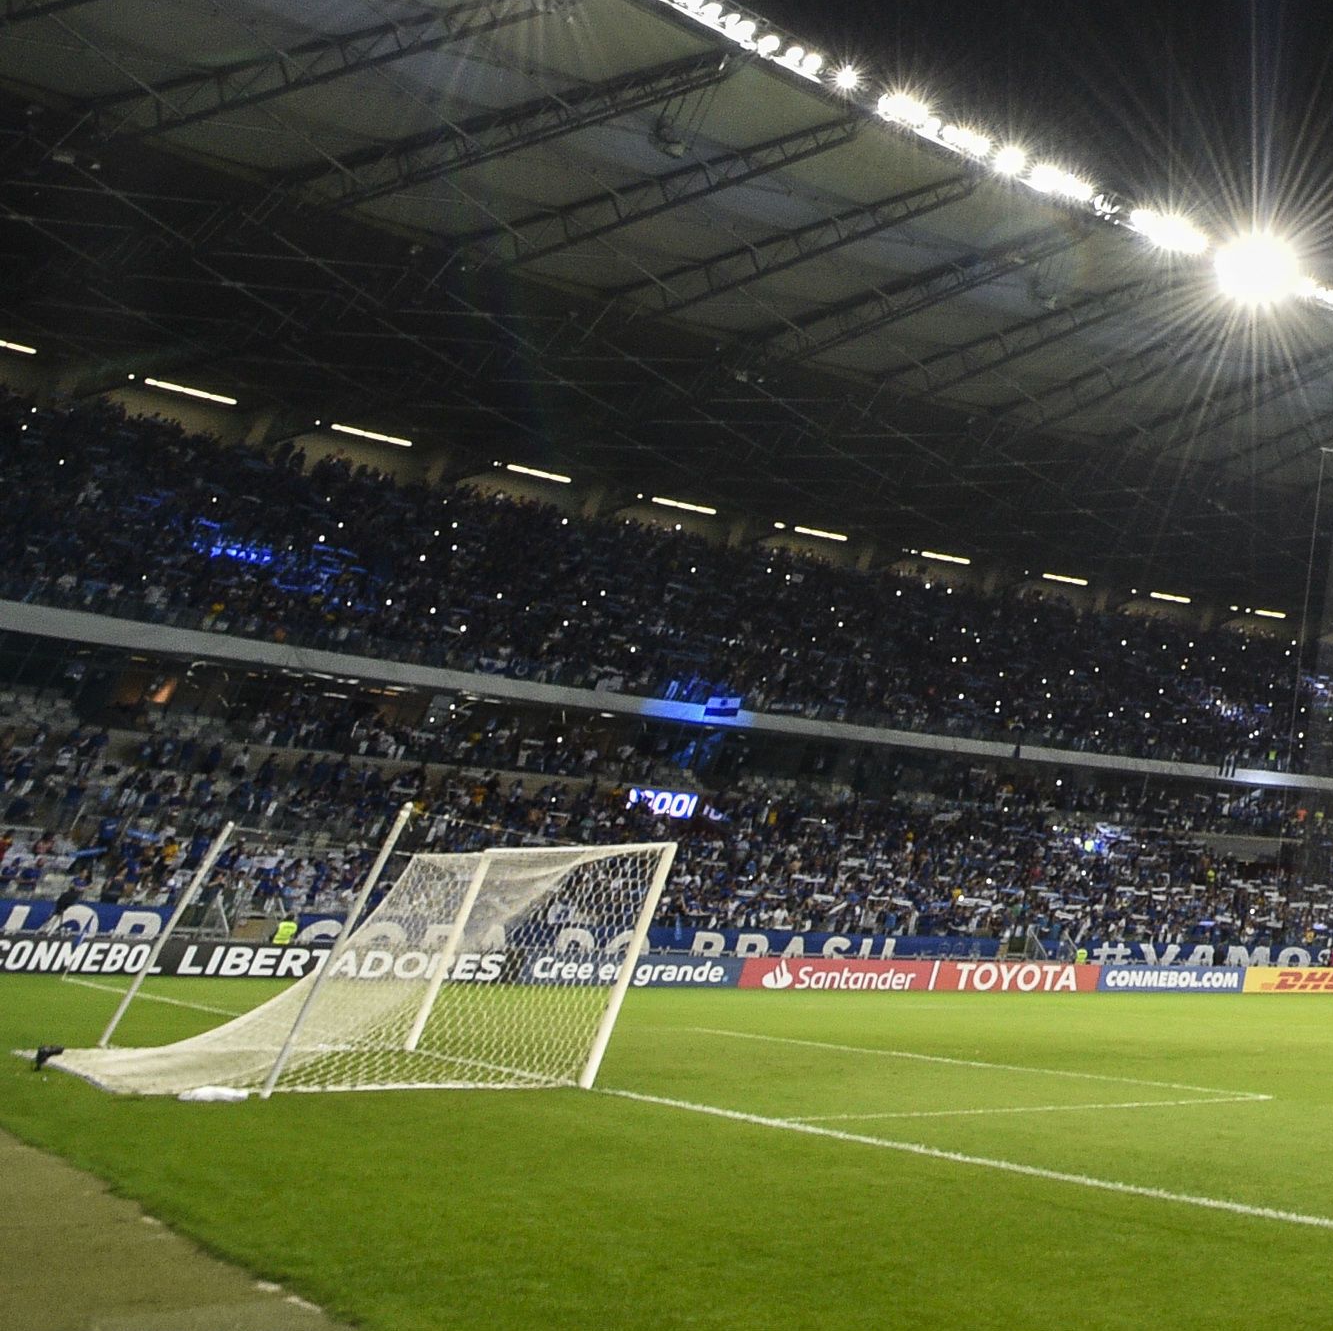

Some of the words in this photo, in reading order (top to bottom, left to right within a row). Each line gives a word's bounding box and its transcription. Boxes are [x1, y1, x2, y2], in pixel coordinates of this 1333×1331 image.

[177, 943, 506, 982] LIBERTADORES
[533, 956, 594, 980] Cree
[795, 963, 915, 990] Santander
[956, 963, 1077, 991] TOYOTA
[1105, 969, 1239, 988] CONMEBOL.COM
